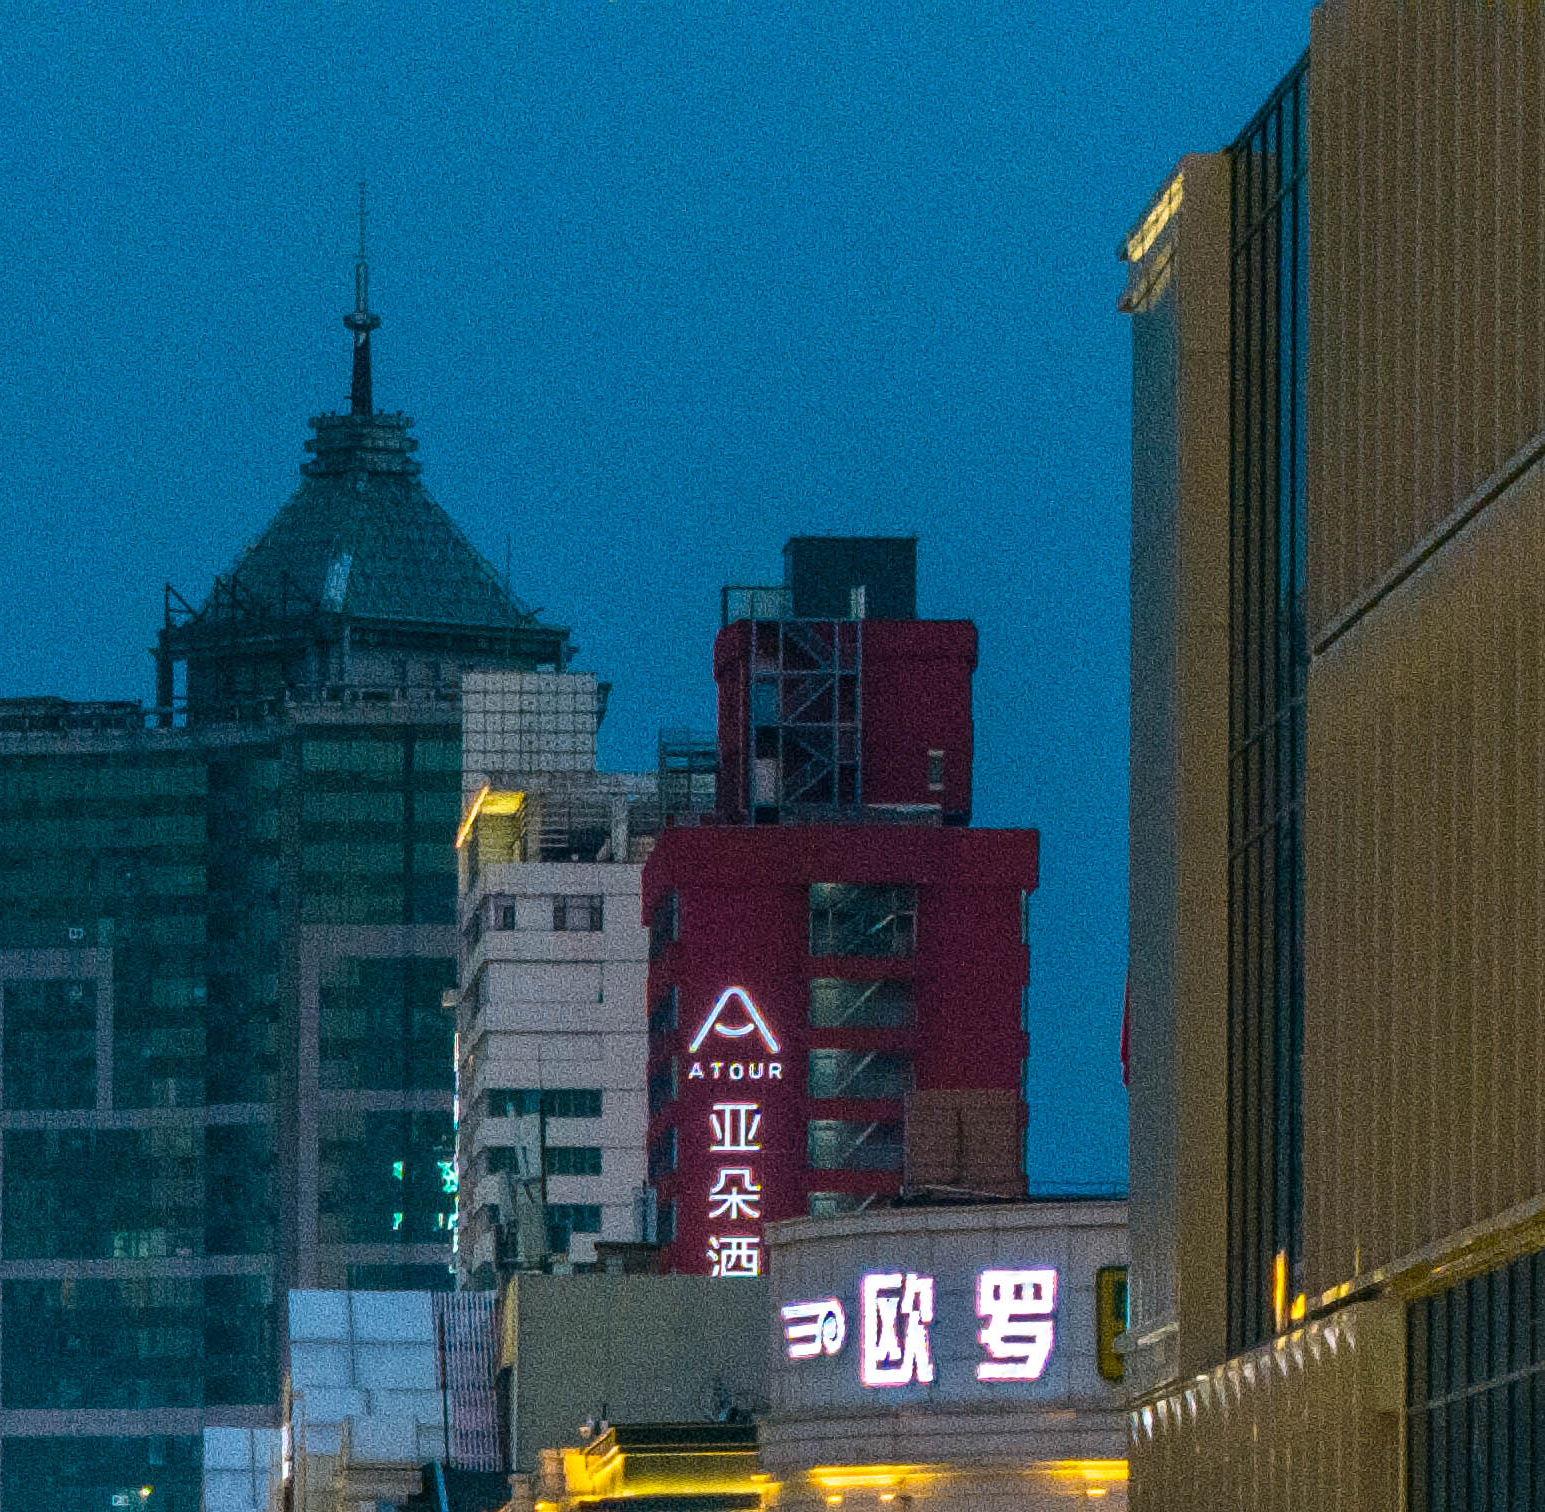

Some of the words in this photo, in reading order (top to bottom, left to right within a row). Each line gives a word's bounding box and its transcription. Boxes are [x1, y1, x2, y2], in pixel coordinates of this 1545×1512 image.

[689, 1060, 784, 1080] ATOUR
[706, 1103, 762, 1278] 亚朵酒
